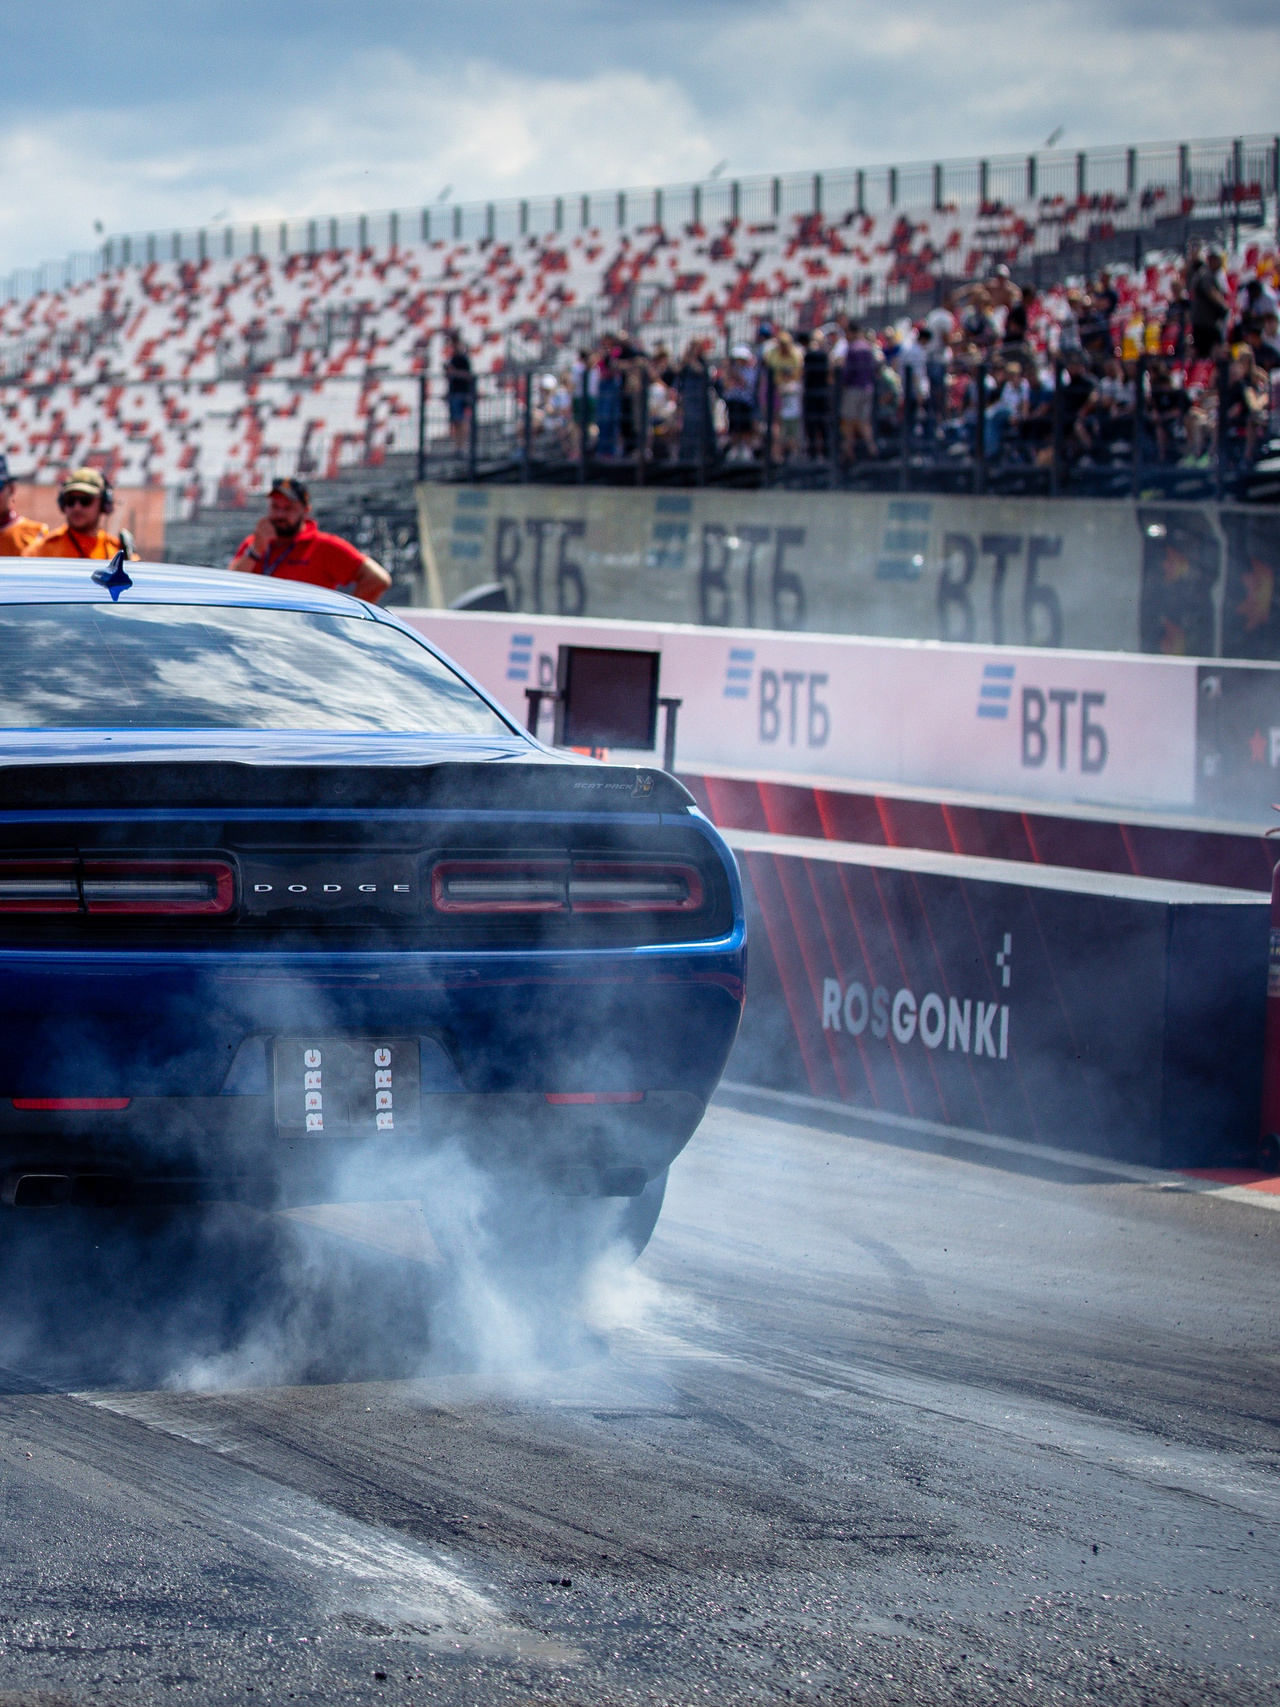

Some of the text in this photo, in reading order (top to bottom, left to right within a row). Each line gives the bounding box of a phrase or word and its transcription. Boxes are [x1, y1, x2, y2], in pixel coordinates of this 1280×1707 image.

[699, 523, 807, 630] ВТБ
[937, 531, 1063, 648] ВТБ
[758, 668, 830, 748] ВТБ
[1020, 686, 1109, 775] ВТБ
[254, 884, 410, 893] DODGE
[822, 976, 1010, 1060] ROSGONKI
[304, 1049, 323, 1132] RDRC
[374, 1048, 394, 1131] RDRC
